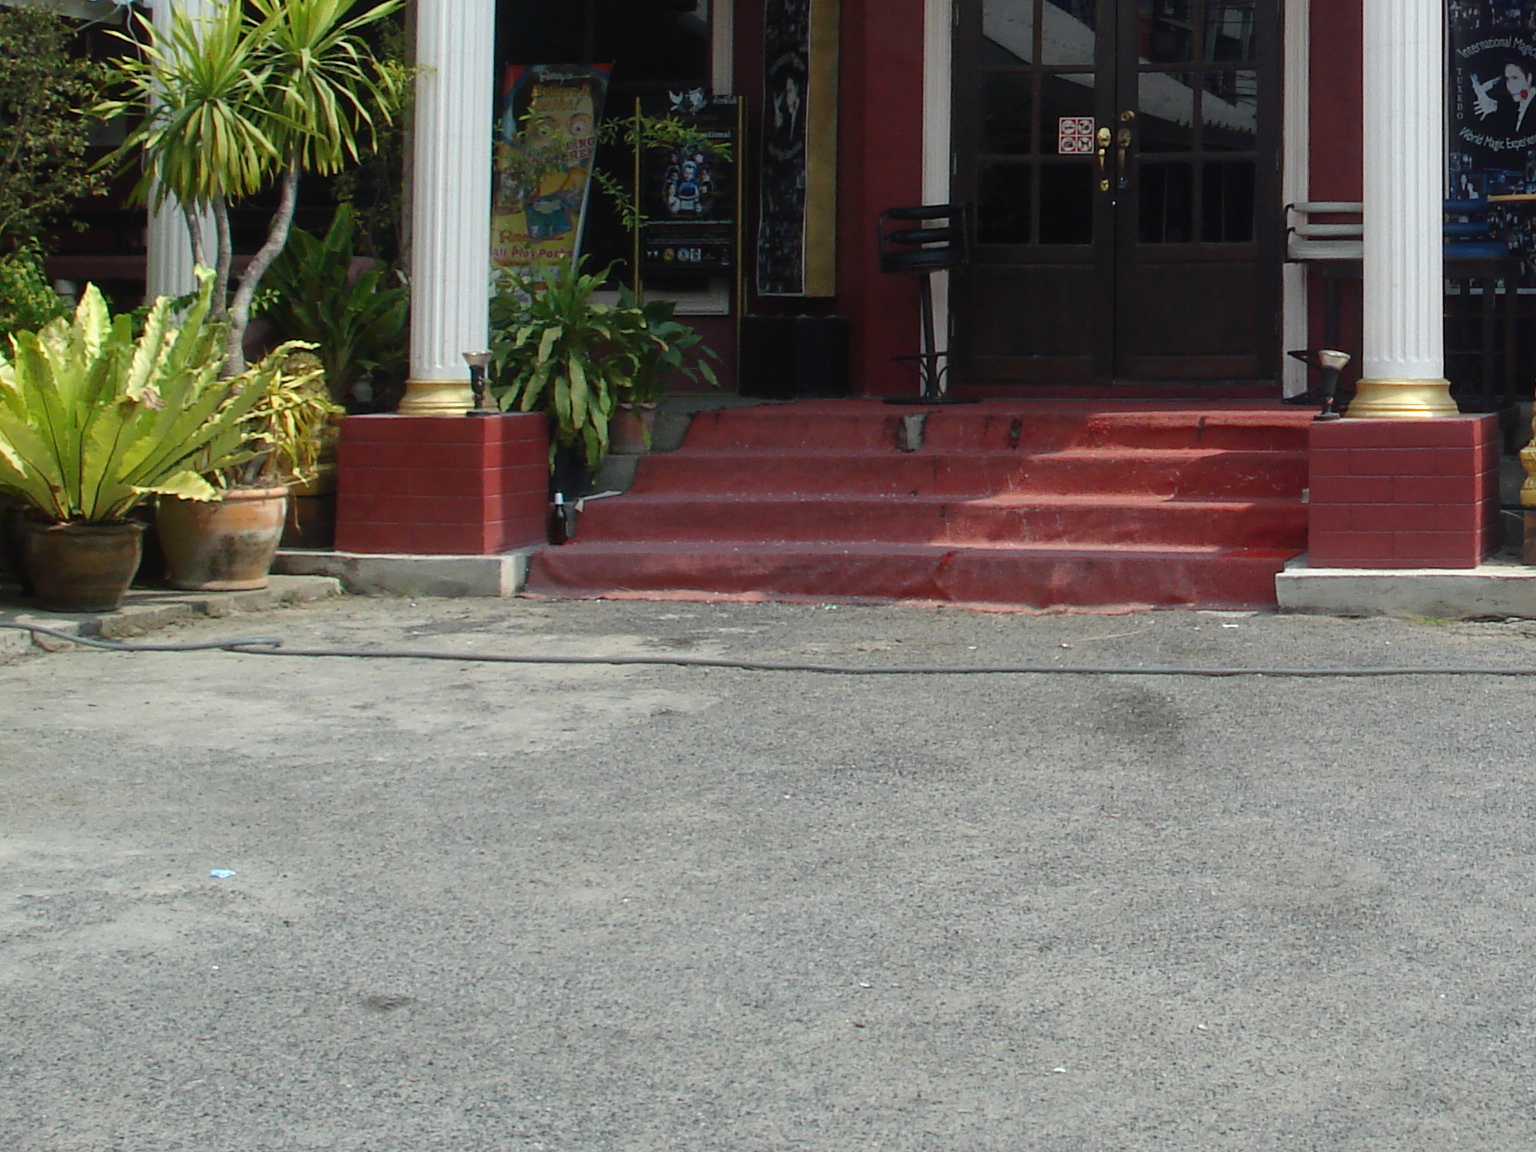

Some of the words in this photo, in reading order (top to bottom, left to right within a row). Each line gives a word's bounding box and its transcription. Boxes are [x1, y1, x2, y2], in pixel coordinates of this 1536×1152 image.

[1457, 35, 1513, 60] International
[1455, 67, 1464, 121] TUXEDO
[1458, 126, 1486, 146] World
[1482, 135, 1506, 152] Magic
